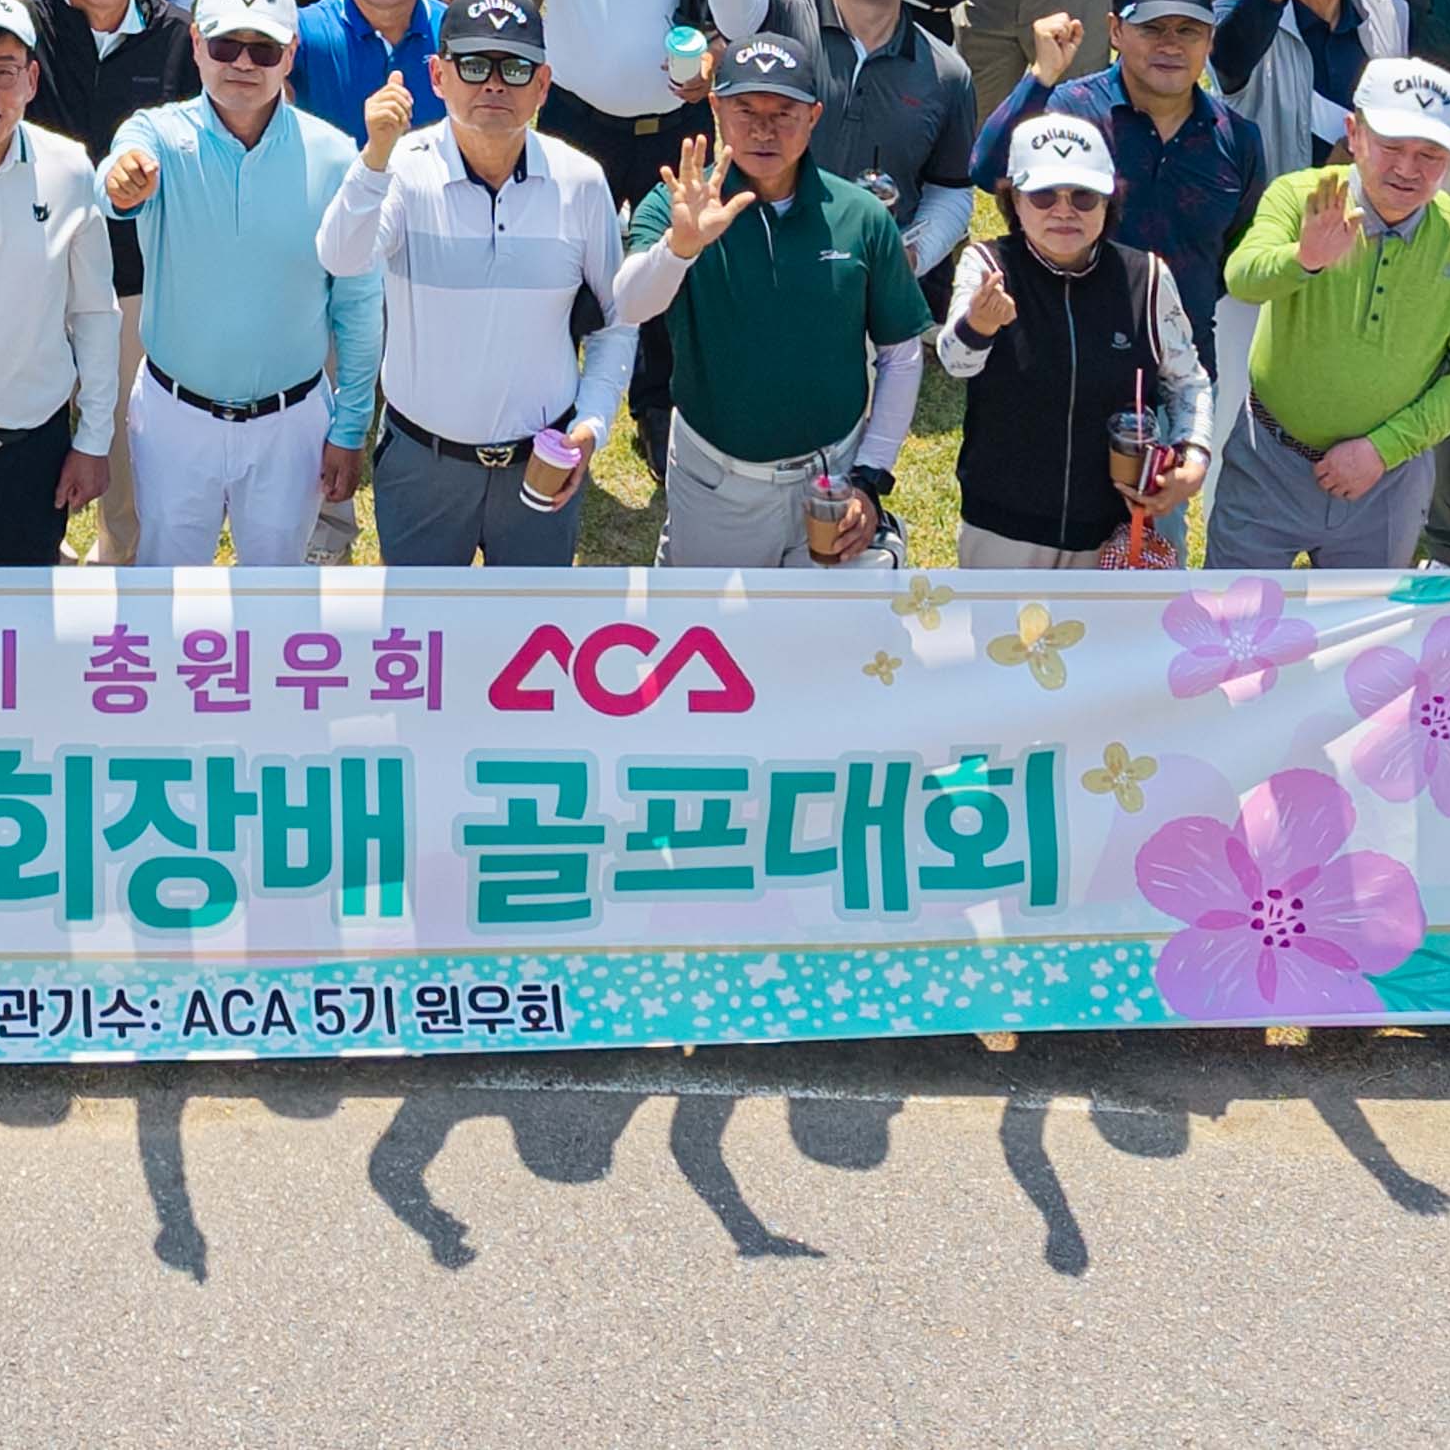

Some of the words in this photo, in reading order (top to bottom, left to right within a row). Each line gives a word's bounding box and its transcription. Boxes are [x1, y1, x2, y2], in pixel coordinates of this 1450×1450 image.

[736, 43, 796, 68] Callaway
[1033, 129, 1091, 151] Callaway
[83, 625, 444, 713] 총원우회
[488, 623, 755, 716] ACA
[464, 751, 1058, 924] 골프대회
[181, 989, 297, 1037] ACA
[312, 987, 397, 1036] 5기
[414, 983, 564, 1034] 원우회
